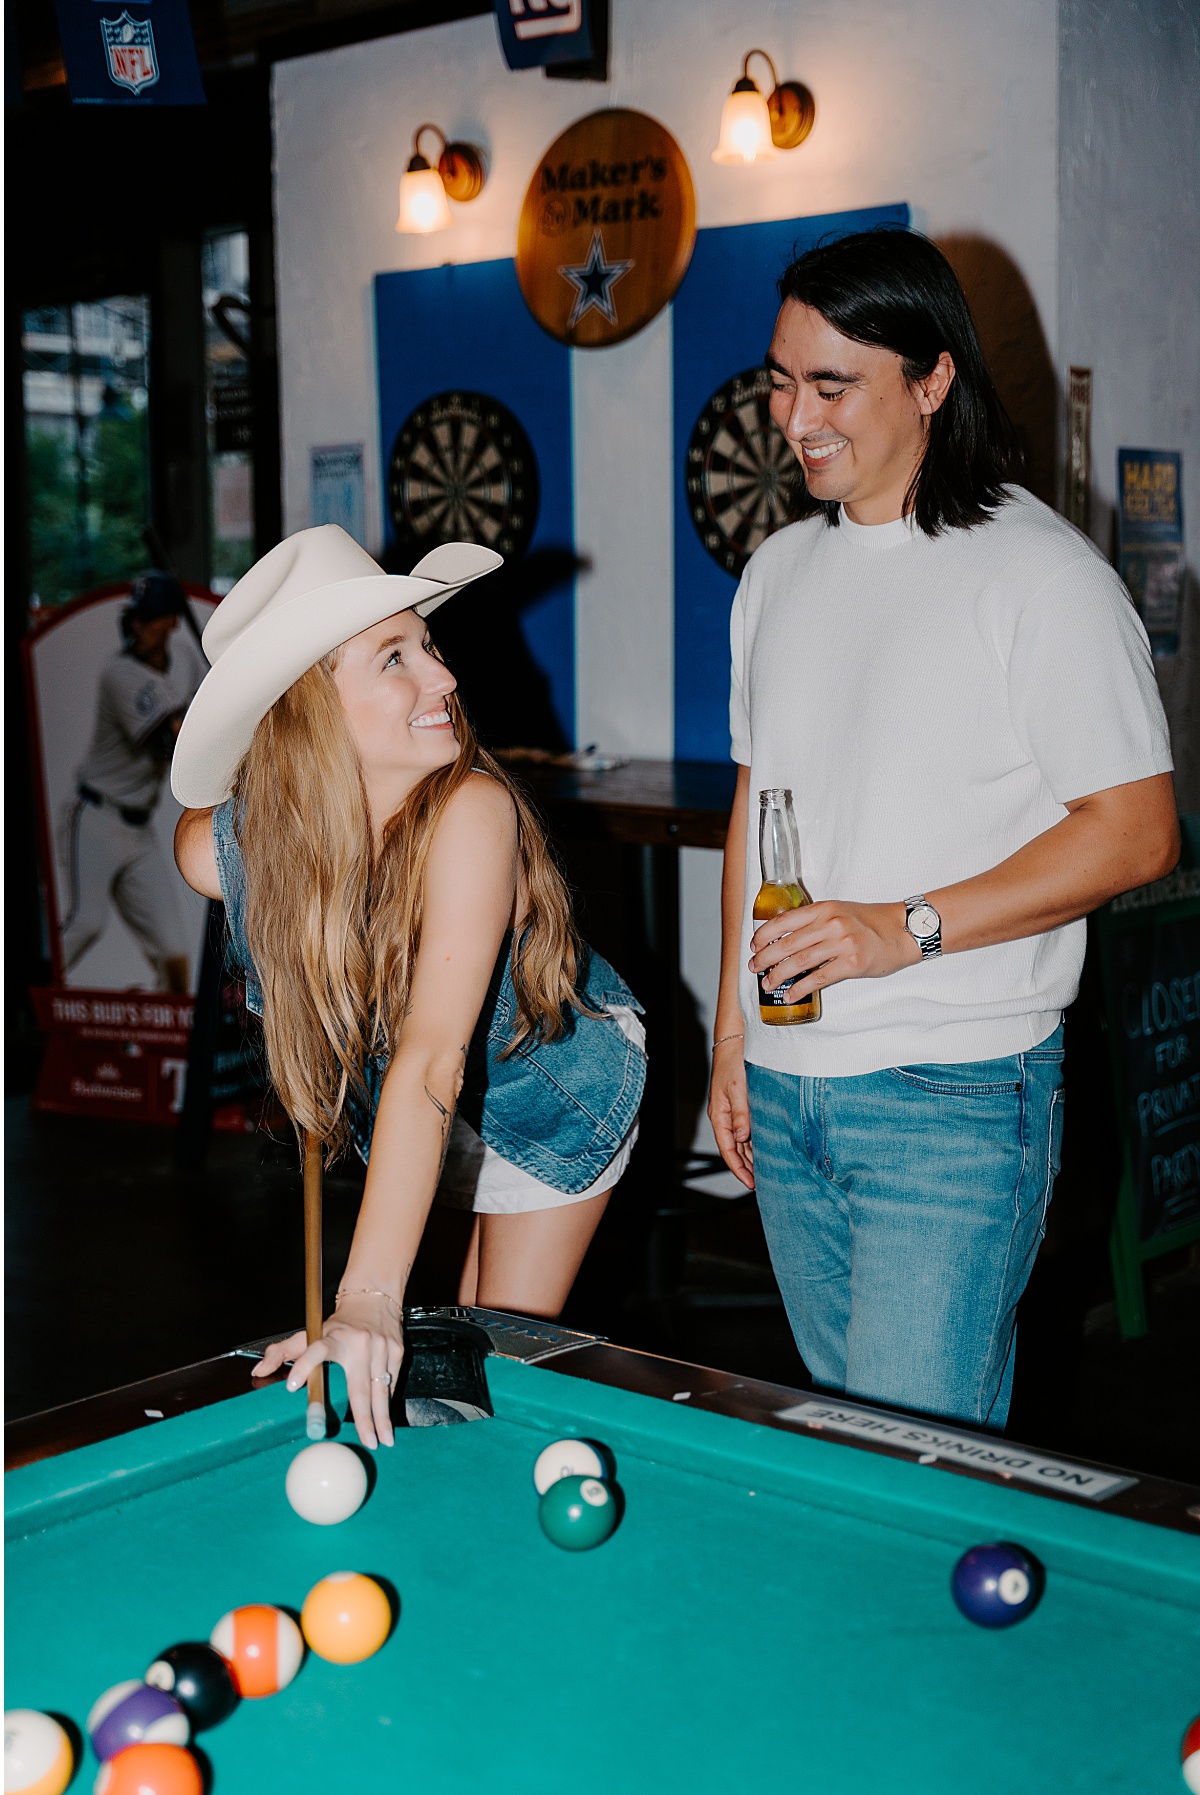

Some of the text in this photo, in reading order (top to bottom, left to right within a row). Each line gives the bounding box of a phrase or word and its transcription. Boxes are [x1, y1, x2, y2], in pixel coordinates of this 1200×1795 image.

[111, 48, 153, 81] NFL
[541, 155, 668, 195] Maker's
[573, 191, 663, 228] Mark
[52, 997, 88, 1023] THIS
[93, 1001, 139, 1027] BUD'S
[143, 1004, 175, 1028] FOR
[1155, 1034, 1192, 1074] FOR
[71, 1077, 143, 1101] Budweiser
[160, 1058, 189, 1113] 7
[804, 1408, 1096, 1488] NO DRINKS HERE
